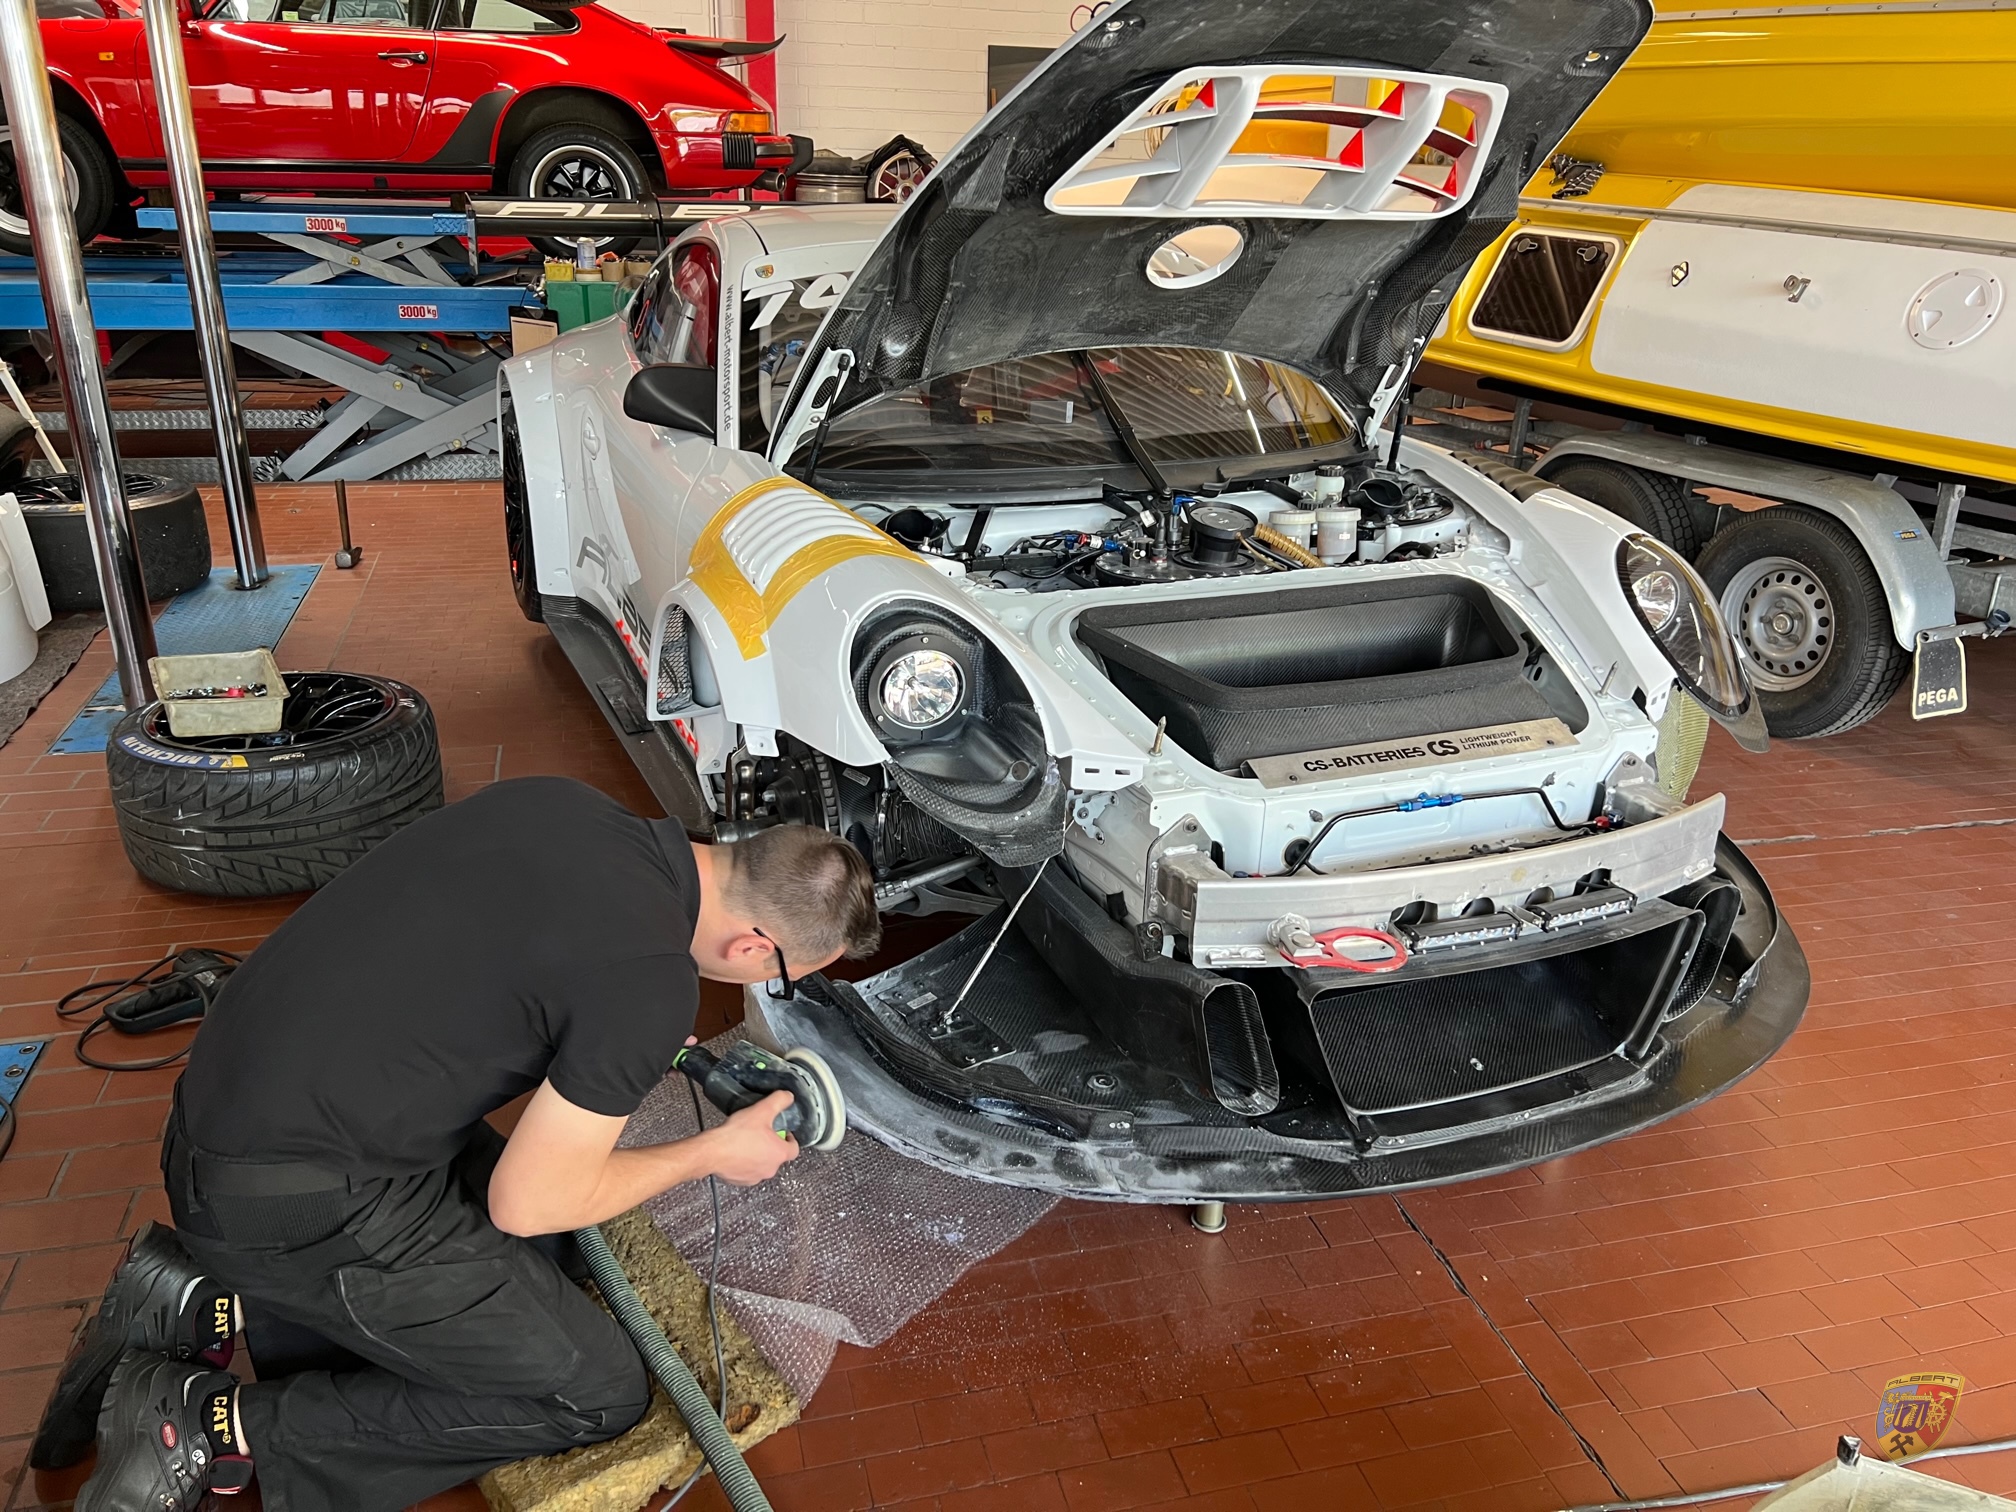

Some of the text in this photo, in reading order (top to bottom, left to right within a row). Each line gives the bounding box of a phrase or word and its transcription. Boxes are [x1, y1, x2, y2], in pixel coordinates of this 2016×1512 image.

[306, 217, 346, 231] 3000 kg
[399, 305, 437, 318] 3000 kg
[721, 284, 735, 432] www.albert-motorsport.de
[1917, 687, 1959, 707] PEGA
[122, 735, 204, 766] MICHELIN
[1303, 730, 1518, 772] CS-BATTERIES CS LIGHTWEIGHT
[1462, 735, 1532, 751] LITHIUM POWER
[214, 1298, 229, 1334] CAT
[212, 1396, 229, 1433] CAT
